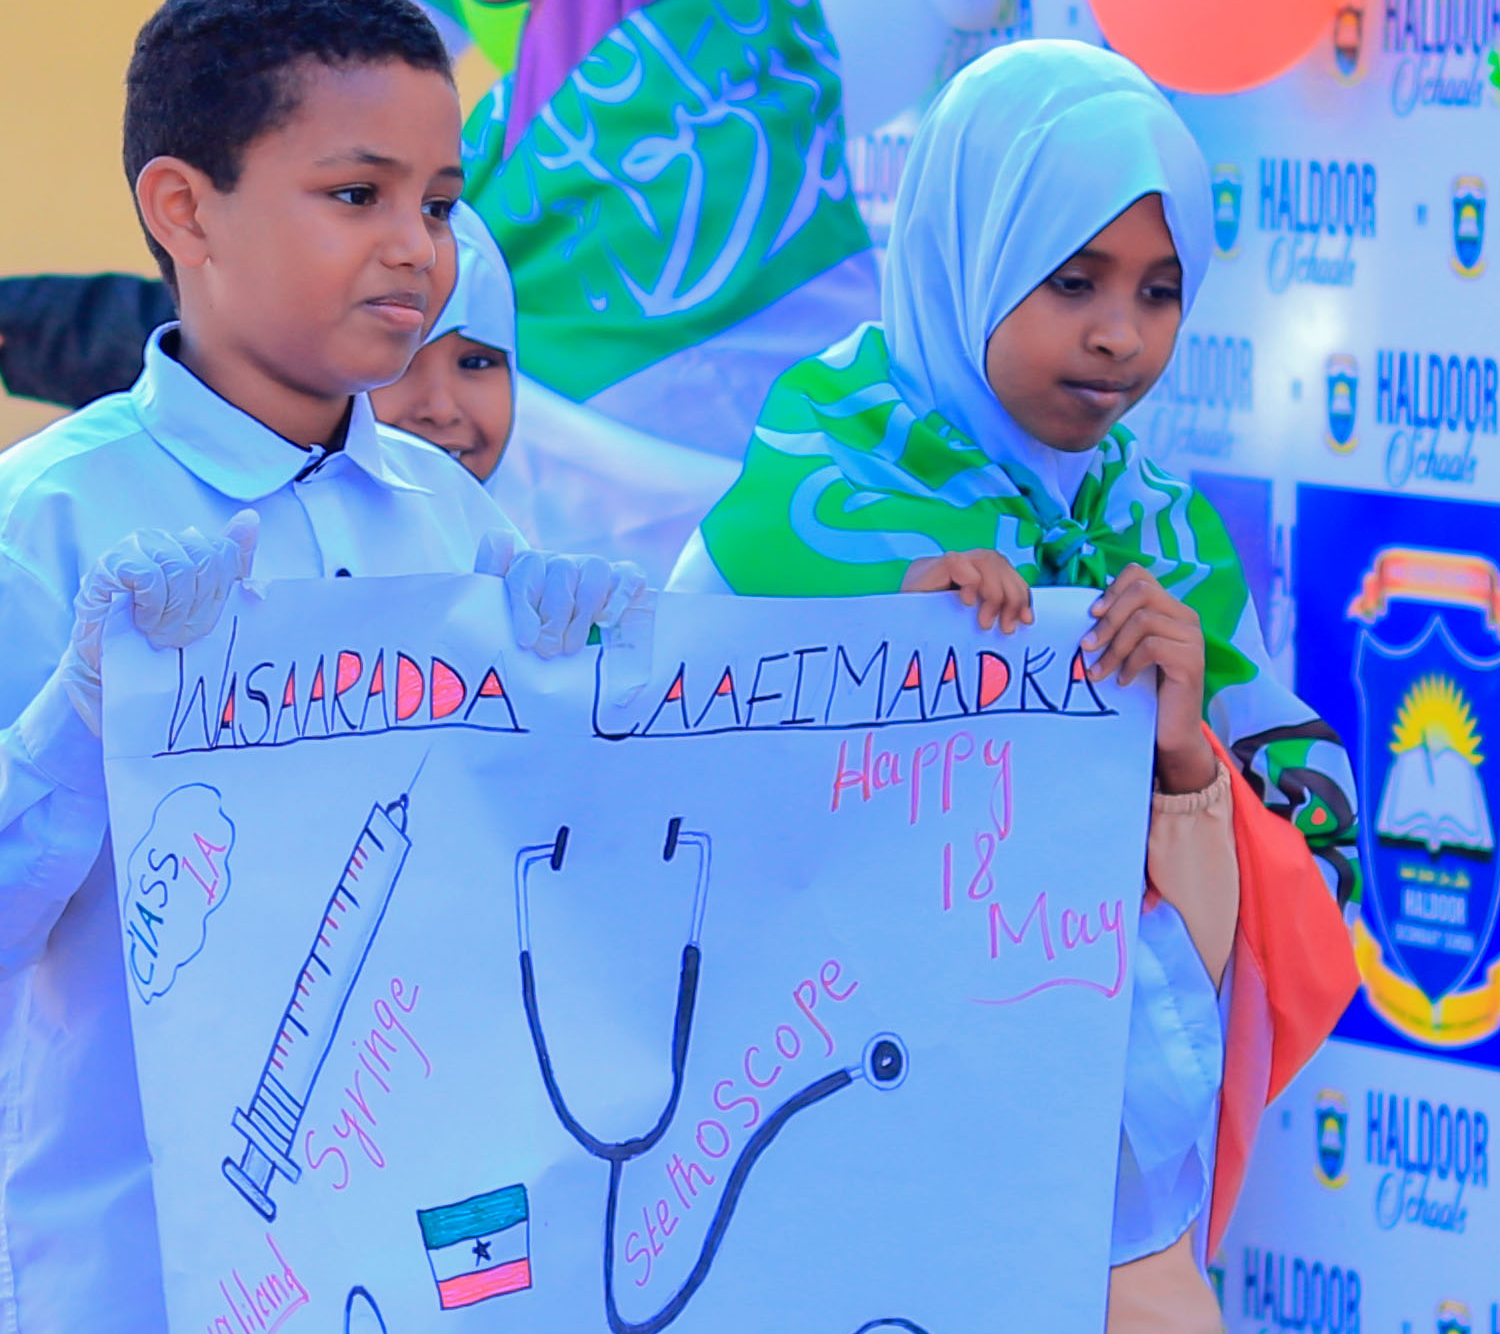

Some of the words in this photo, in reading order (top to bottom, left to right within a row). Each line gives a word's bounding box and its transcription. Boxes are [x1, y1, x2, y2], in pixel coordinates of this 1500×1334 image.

[1259, 158, 1376, 237] HALDOOR
[1376, 349, 1498, 434] HALDOOR
[168, 616, 519, 749] WASAARADDA
[831, 731, 1011, 841] Happy
[943, 830, 996, 911] 18
[989, 891, 1127, 999] May
[304, 977, 432, 1191] Syringe
[1366, 1090, 1490, 1189] HALDOOR
